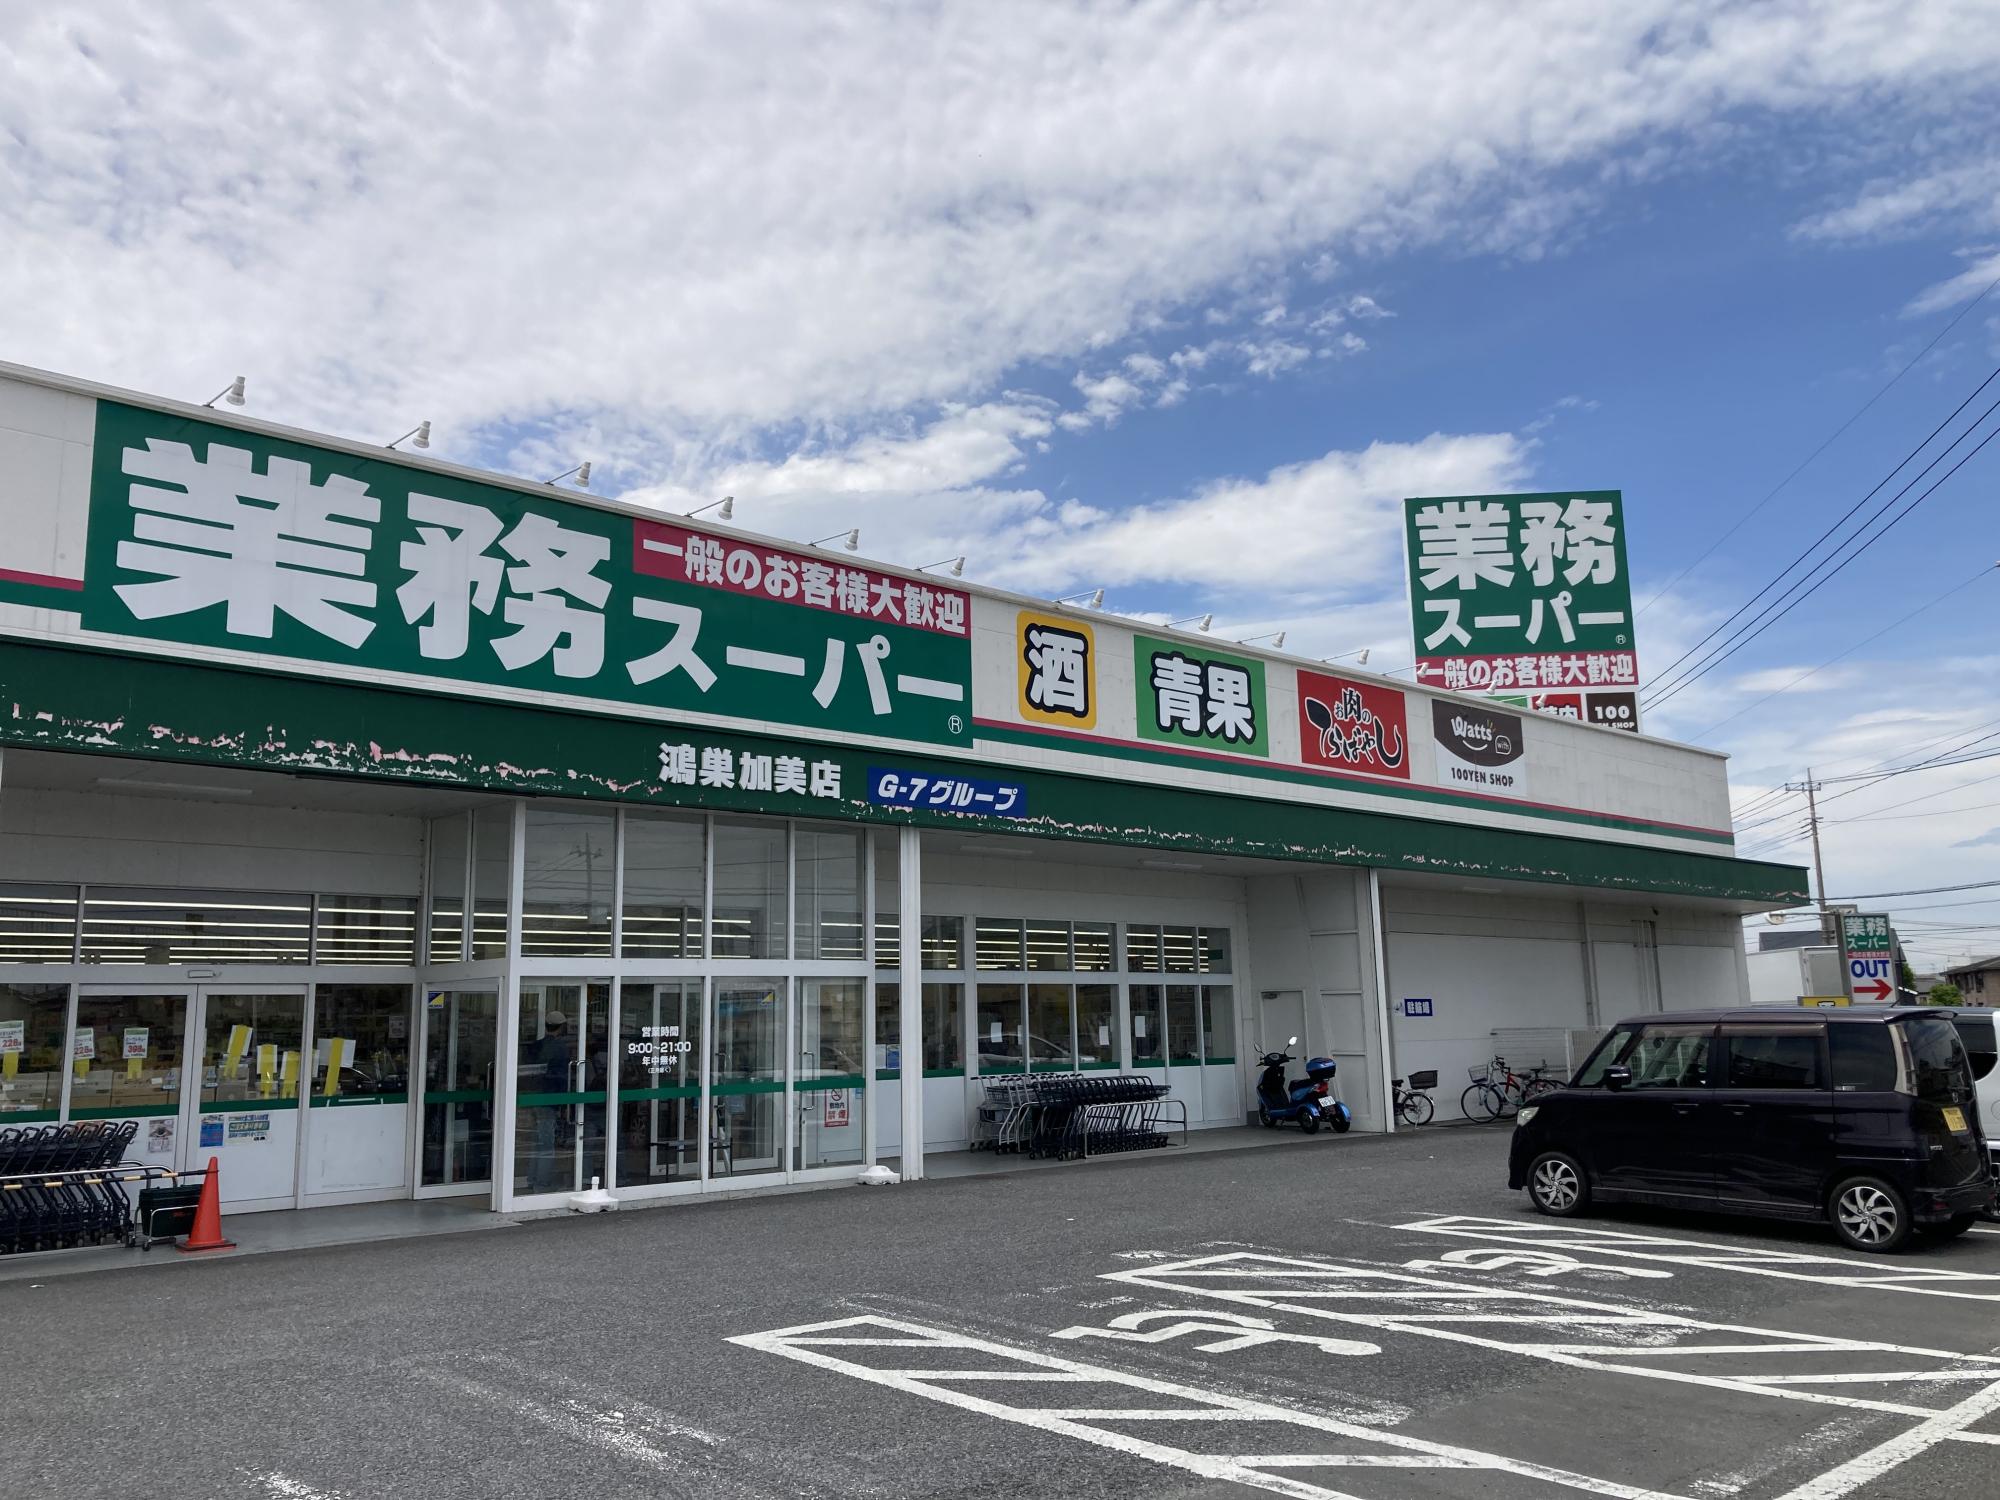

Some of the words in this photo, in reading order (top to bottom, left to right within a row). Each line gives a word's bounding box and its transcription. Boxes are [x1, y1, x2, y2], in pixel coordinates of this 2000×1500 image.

[113, 437, 612, 678] 業務
[1415, 499, 1617, 591] 業務
[643, 534, 966, 636] 一般のお客様大歓迎
[1424, 591, 1625, 651] スーパー
[625, 596, 964, 716] スーパー
[1027, 626, 1087, 715] 酒
[1424, 654, 1635, 688] 一般のお客様大歓迎
[1153, 655, 1255, 741] 青果
[1594, 706, 1630, 719] 100
[1451, 716, 1493, 741] Watts
[658, 742, 841, 798] 鴻巣加美店
[1451, 767, 1486, 783] 100YEN
[1489, 773, 1514, 787] SHOP
[1846, 917, 1887, 936] 業務
[1847, 937, 1889, 949] スーパー
[1851, 960, 1890, 978] OUT
[642, 1026, 679, 1037] 営業時間
[642, 1055, 678, 1066] 年中無休
